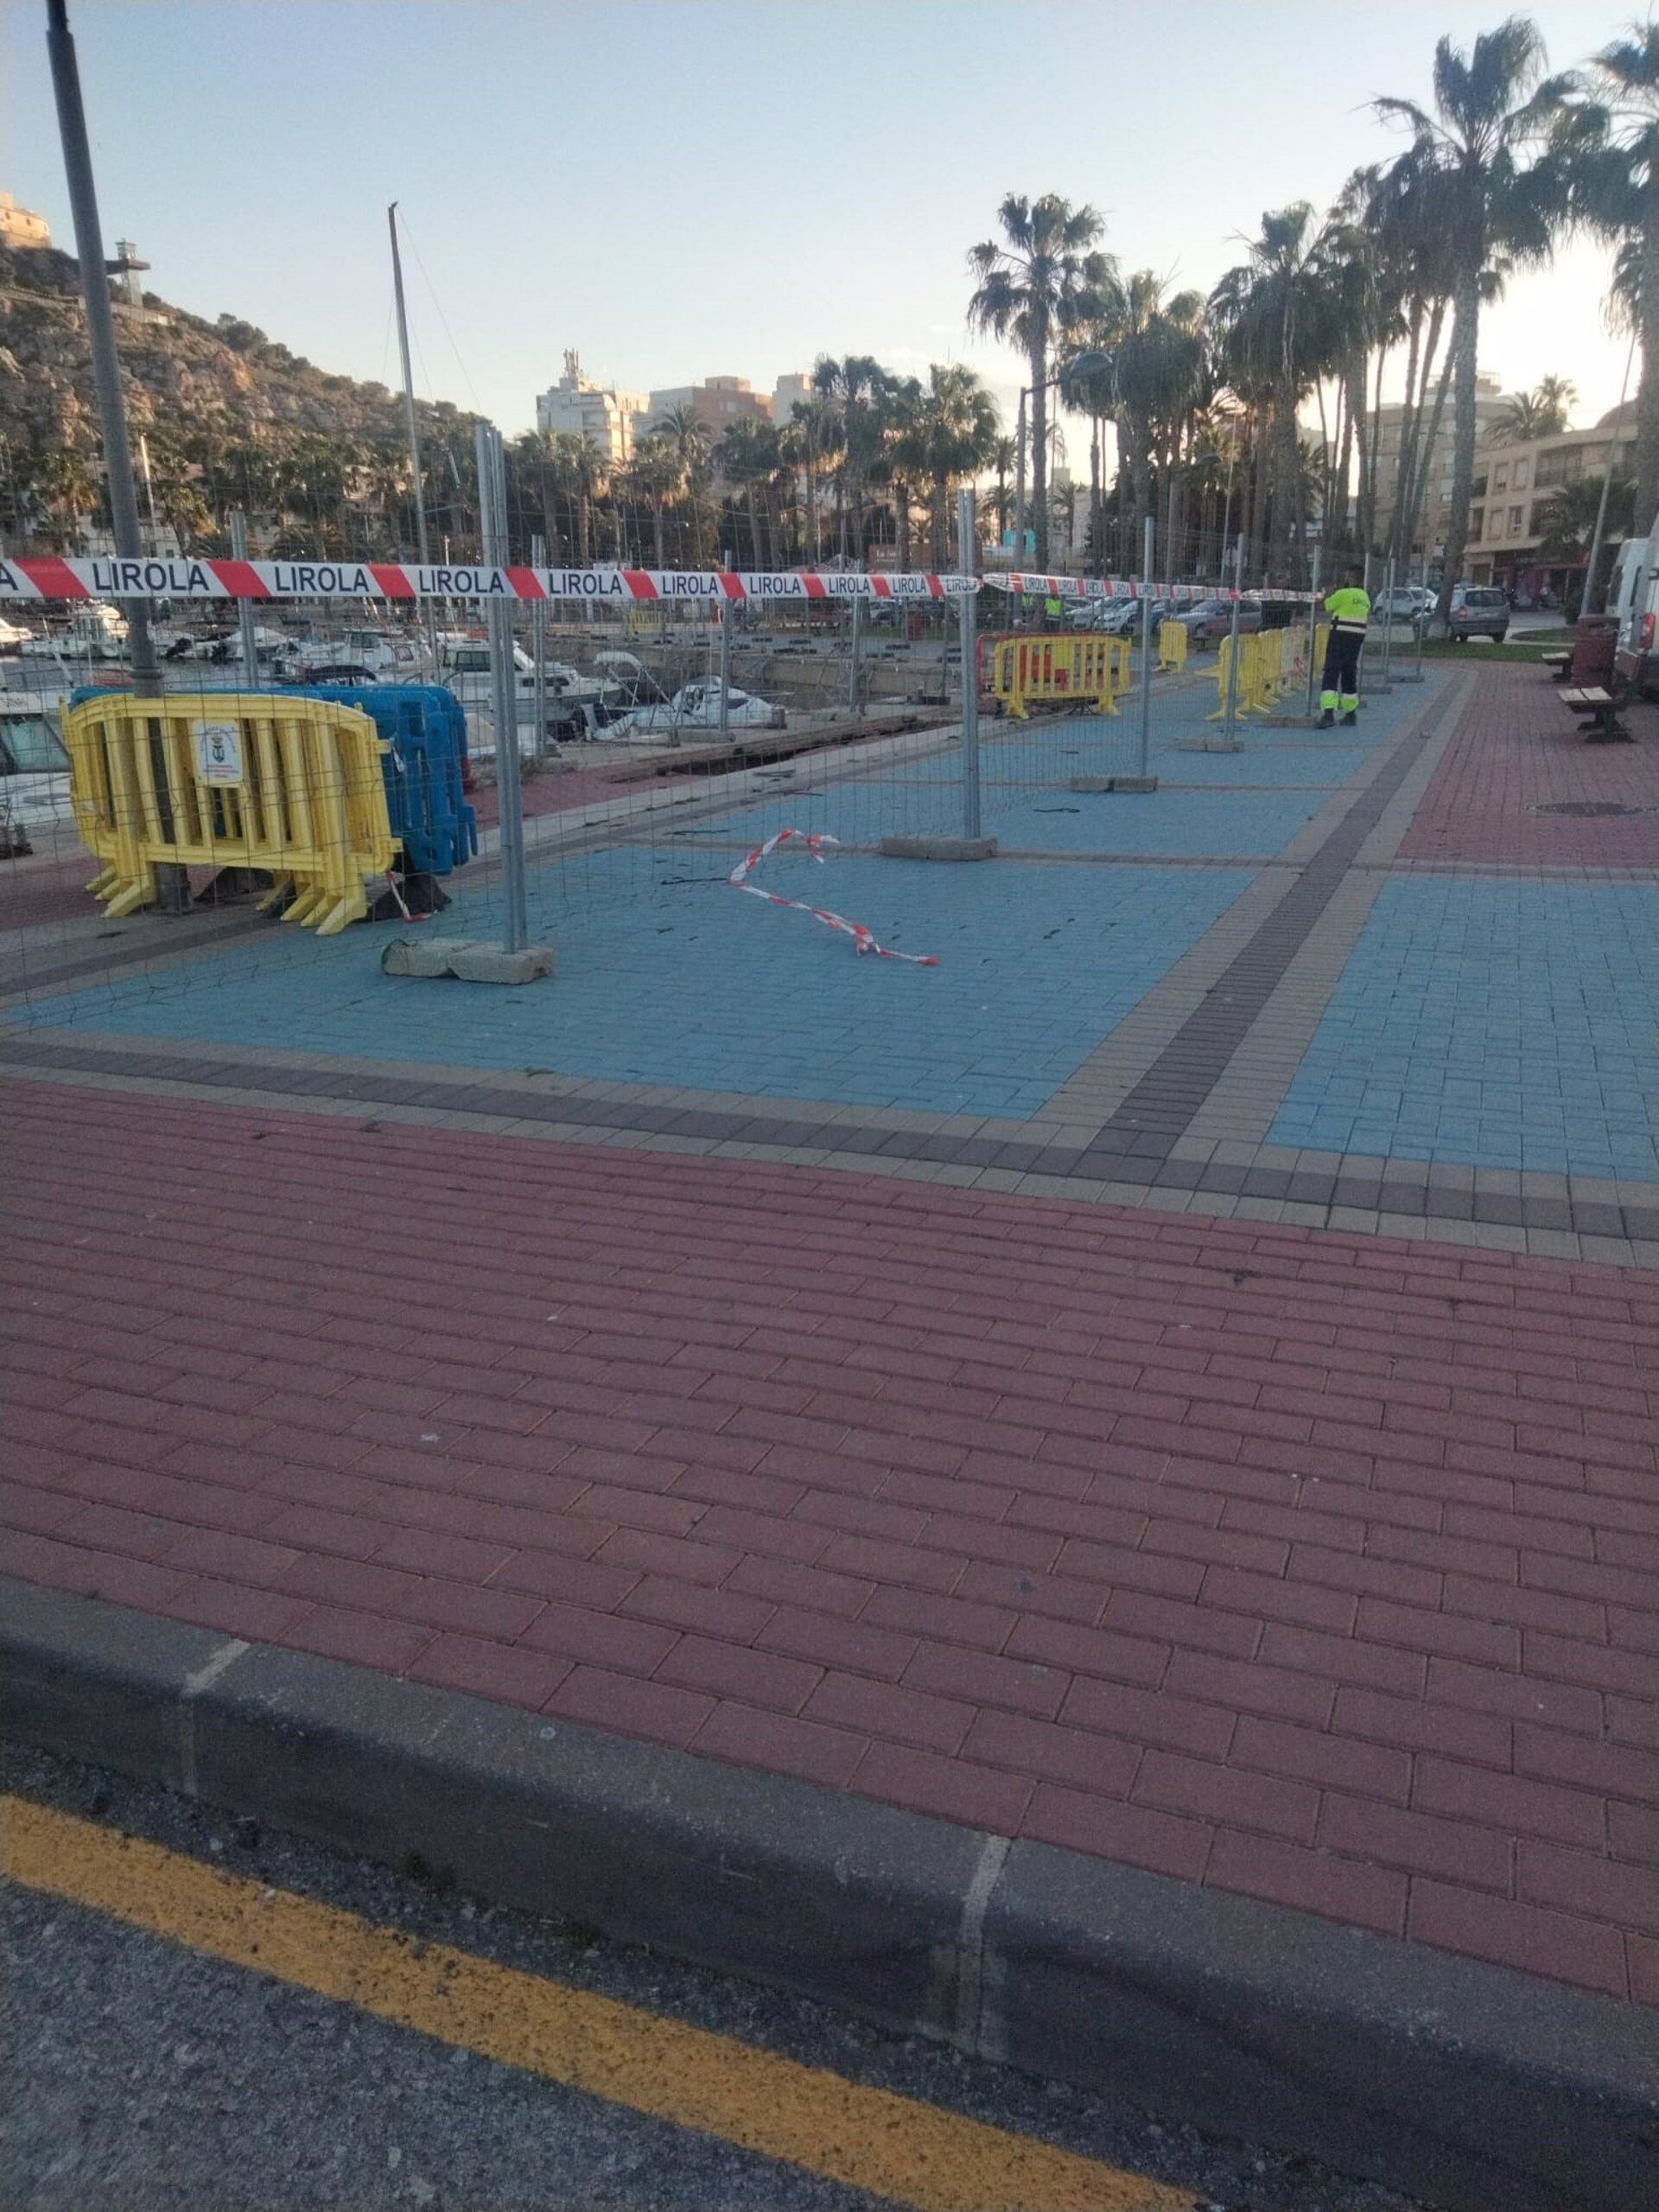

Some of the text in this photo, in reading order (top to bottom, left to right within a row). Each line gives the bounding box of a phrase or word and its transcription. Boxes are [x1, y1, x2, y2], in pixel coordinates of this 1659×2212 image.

[92, 563, 209, 592] LIROLA
[274, 566, 370, 593] LIROLA
[418, 569, 505, 594] LIROLA
[548, 573, 623, 595] LIROLA
[662, 575, 719, 595] LIROLA
[749, 575, 801, 595] LIROLA
[828, 576, 871, 594] LIROLA
[892, 577, 926, 594] LIROLA
